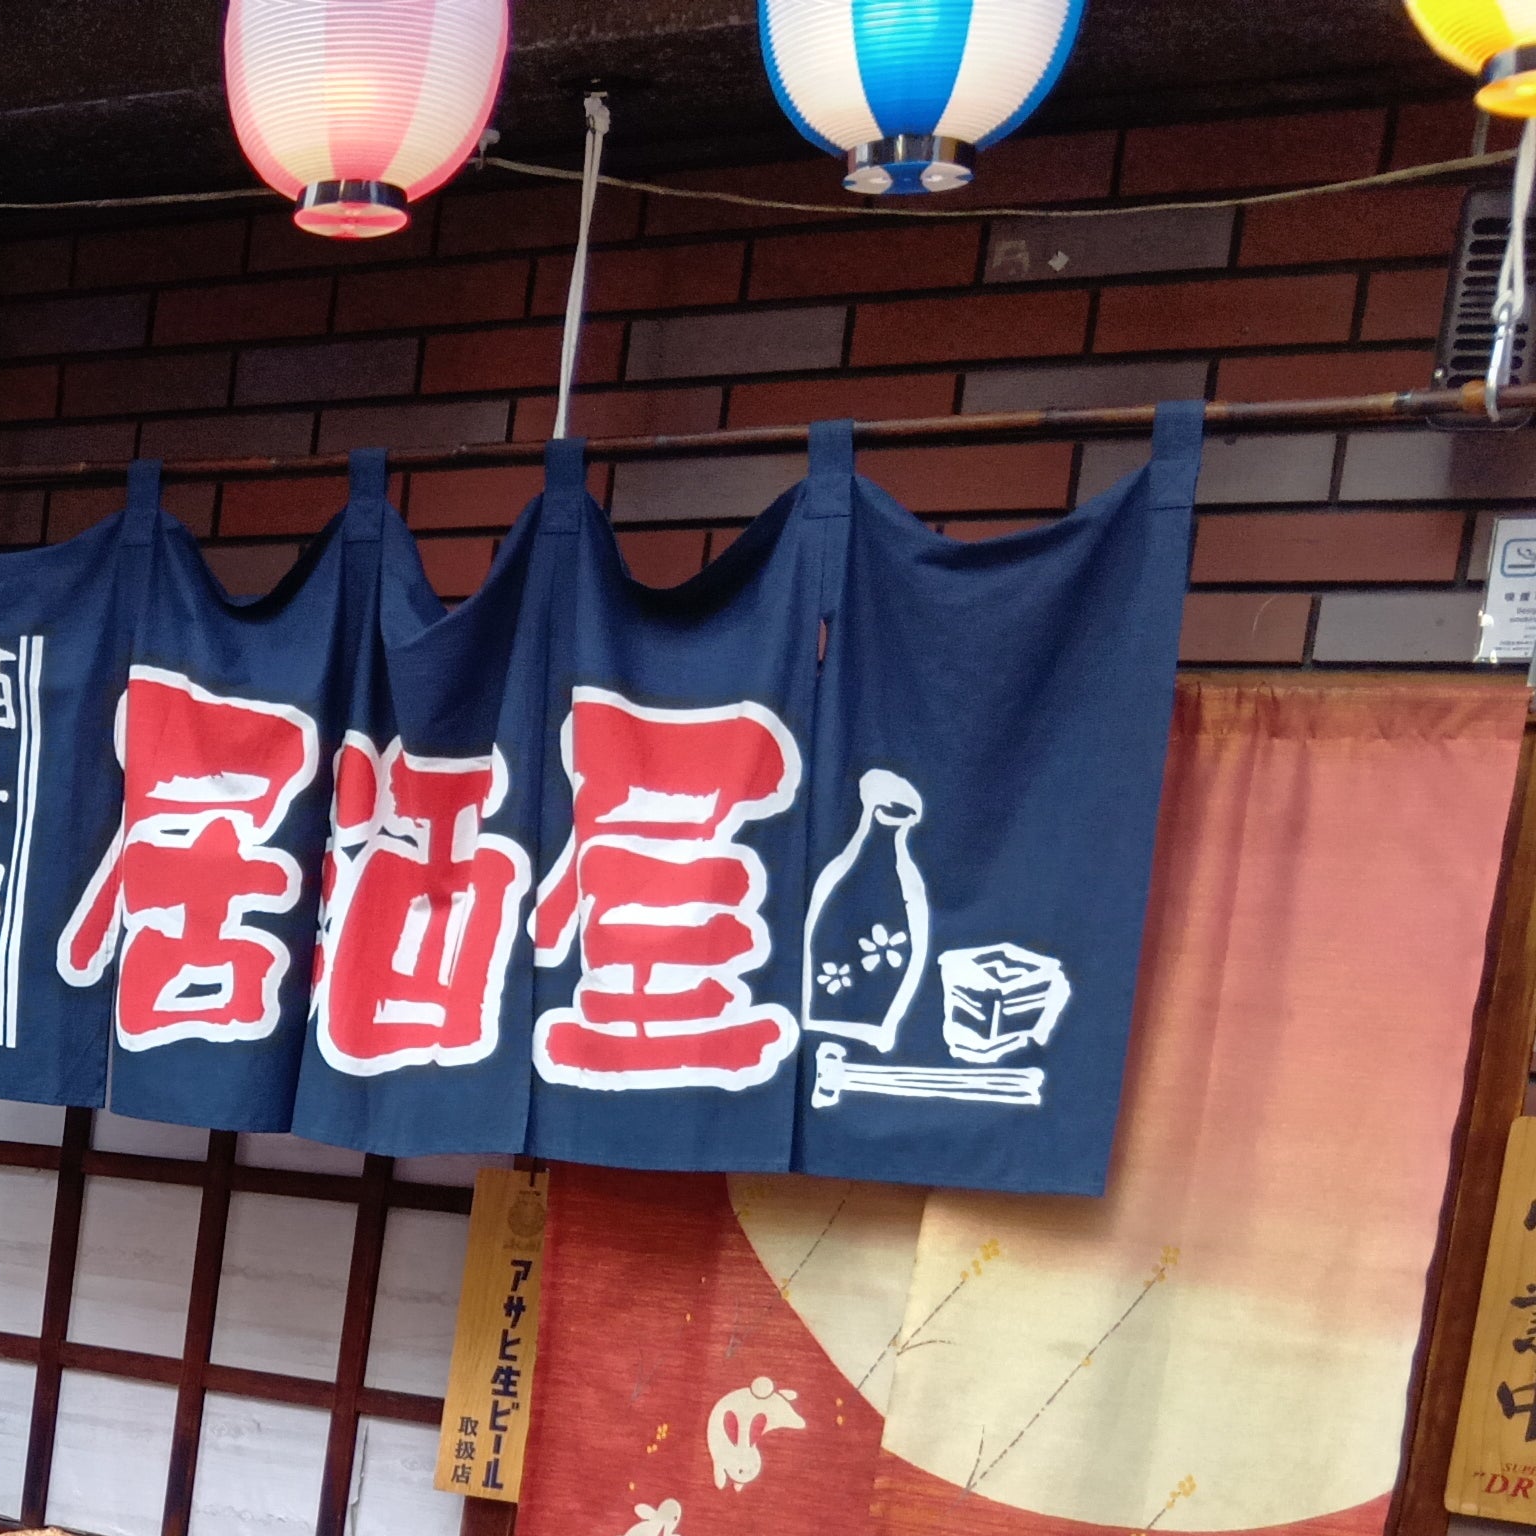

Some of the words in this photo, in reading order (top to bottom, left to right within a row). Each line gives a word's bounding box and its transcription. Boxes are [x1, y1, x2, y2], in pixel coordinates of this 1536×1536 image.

[56, 663, 803, 1091] 居酒屋
[450, 1416, 479, 1485] 取扱店
[481, 1258, 533, 1490] アサヒ生ビール
